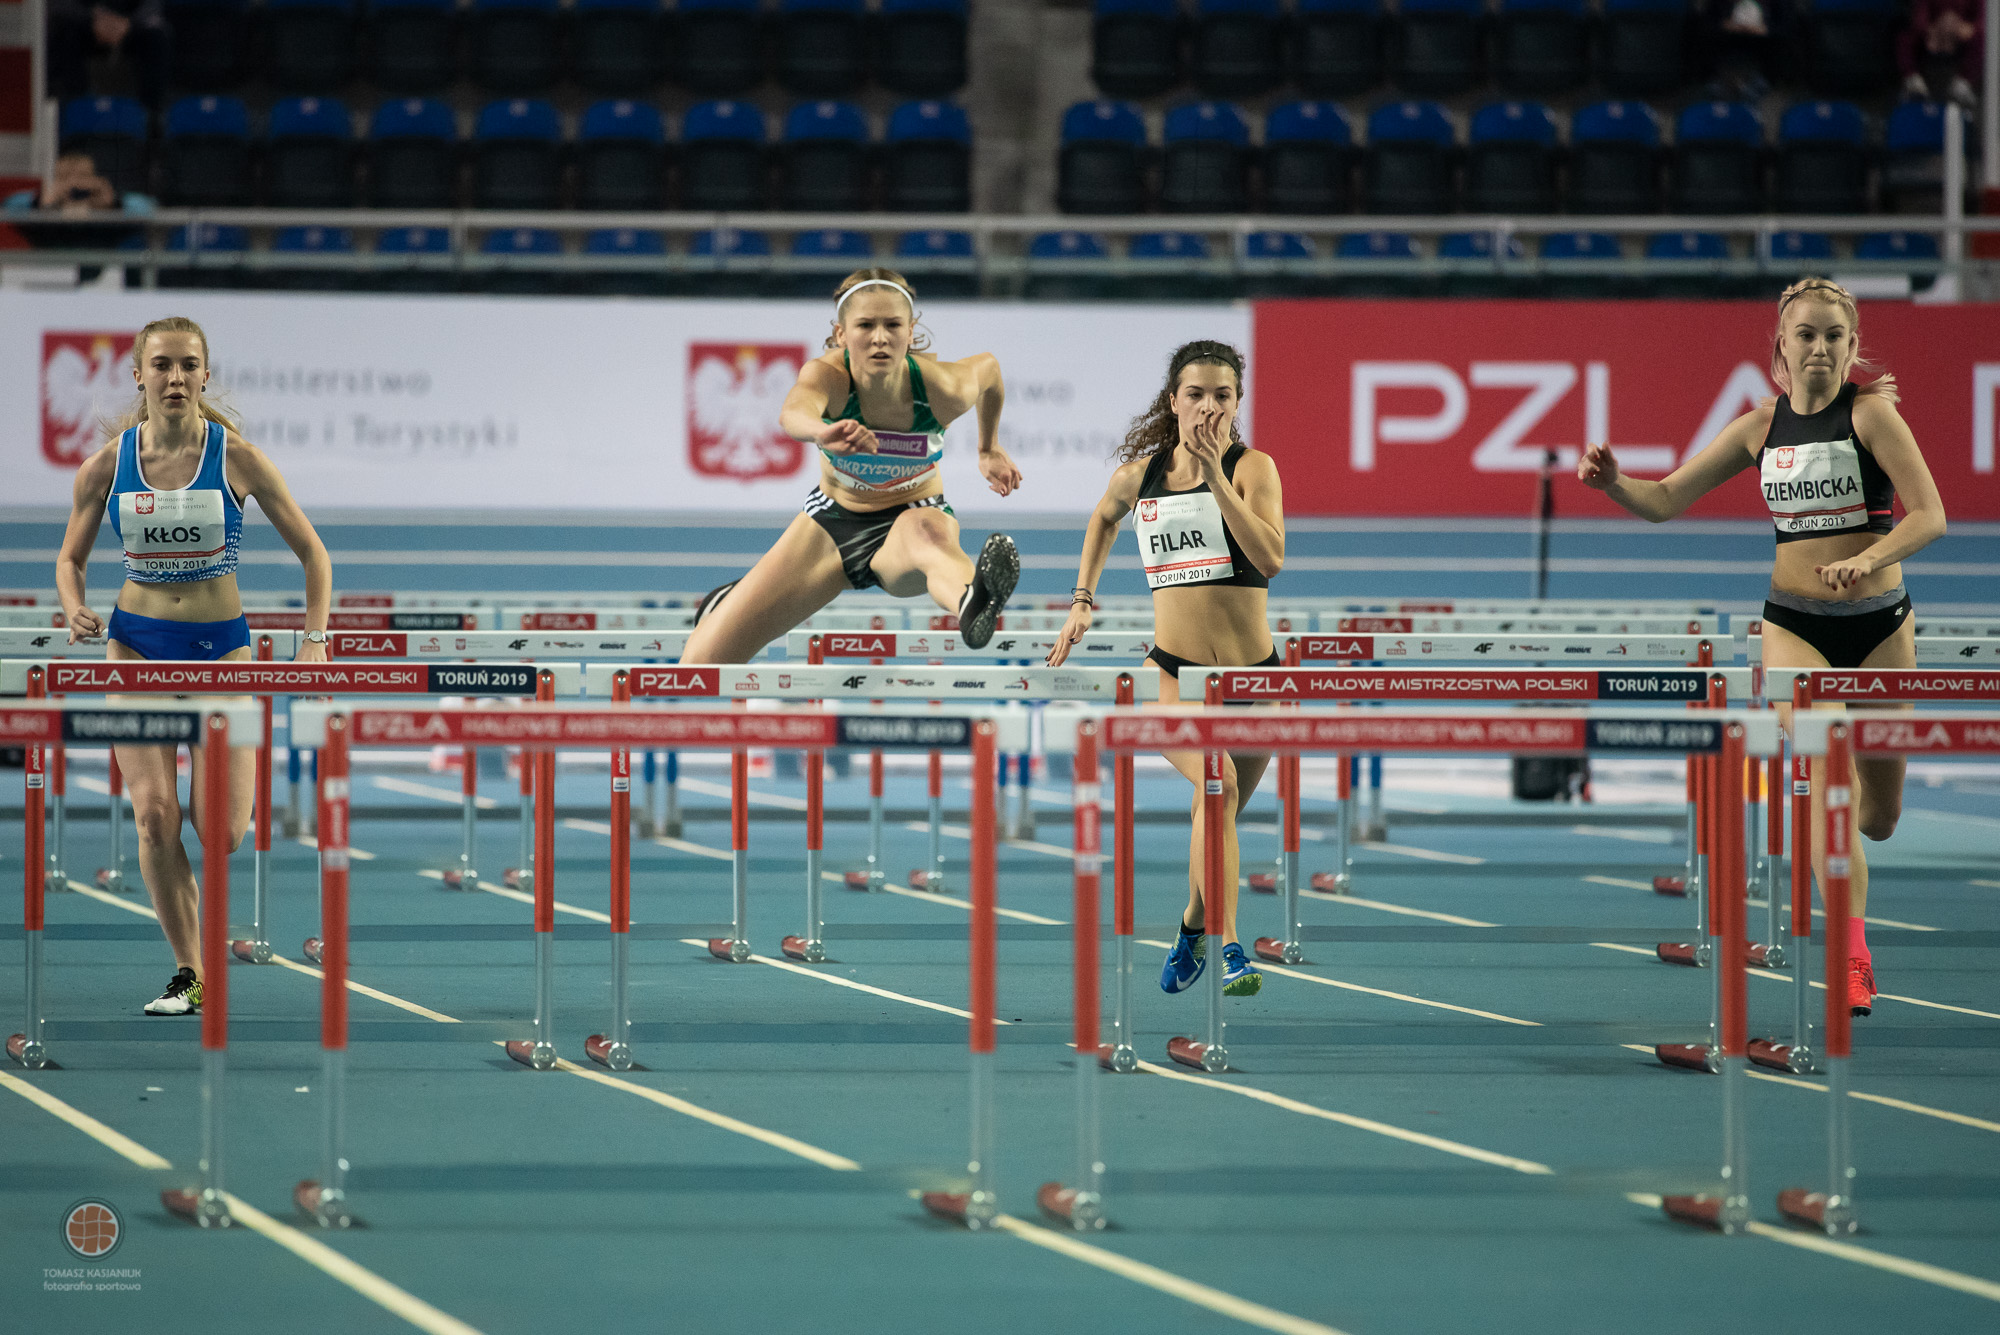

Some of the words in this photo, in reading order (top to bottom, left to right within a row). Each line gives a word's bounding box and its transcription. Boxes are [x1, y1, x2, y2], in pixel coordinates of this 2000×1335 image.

[211, 360, 431, 396] inisterstwo
[836, 458, 930, 478] SKRZYSZOWSK
[1764, 475, 1859, 502] ZIEMBICKA
[1821, 517, 1846, 527] 2019
[143, 526, 201, 544] KŁOS
[1149, 530, 1207, 554] FILAR
[144, 559, 179, 570] TORUŃ
[183, 560, 207, 569] 2019
[1156, 570, 1186, 584] TORUŃ
[1189, 569, 1211, 580] 2019
[31, 636, 52, 648] 4F
[340, 638, 396, 651] PZLA
[508, 639, 529, 650] 4F
[831, 638, 886, 652] PZLA
[996, 640, 1017, 652] 4F
[1308, 640, 1363, 654] PZLA
[1474, 643, 1494, 654] 4F
[1959, 646, 1980, 658] 4F
[57, 669, 125, 686] PZLA
[137, 670, 213, 684] HALOWE
[217, 671, 350, 684] MISTRZOSTWA
[354, 672, 418, 685] POLSKI
[437, 669, 488, 686] TORUŃ
[491, 672, 528, 687] 2019
[640, 673, 708, 690] PZLA
[842, 675, 867, 689] 4F
[953, 680, 987, 689] 4MOVE
[1232, 676, 1299, 693] PZLA
[1310, 678, 1385, 691] HALOWE
[1389, 678, 1520, 691] MISTRZOSTWA
[1525, 678, 1588, 691] POLSKI
[1607, 676, 1659, 692] TORUŃ
[1661, 679, 1698, 692] 2019
[1820, 677, 1887, 693] PZLA
[1899, 679, 1974, 691] HALOWE
[72, 713, 140, 737] TORUŃ
[144, 714, 192, 738] 2019
[360, 713, 450, 739] PZLA
[461, 715, 562, 737] HALOWE
[564, 716, 733, 738] MISTRZOSTWA
[740, 716, 825, 739] POLSKI
[1111, 720, 1201, 745] PZLA
[1212, 721, 1311, 743] HALOWE
[1315, 721, 1484, 744] MISTRZOSTWA
[1488, 722, 1574, 744] POLSKI
[1862, 722, 1952, 748] PZLA
